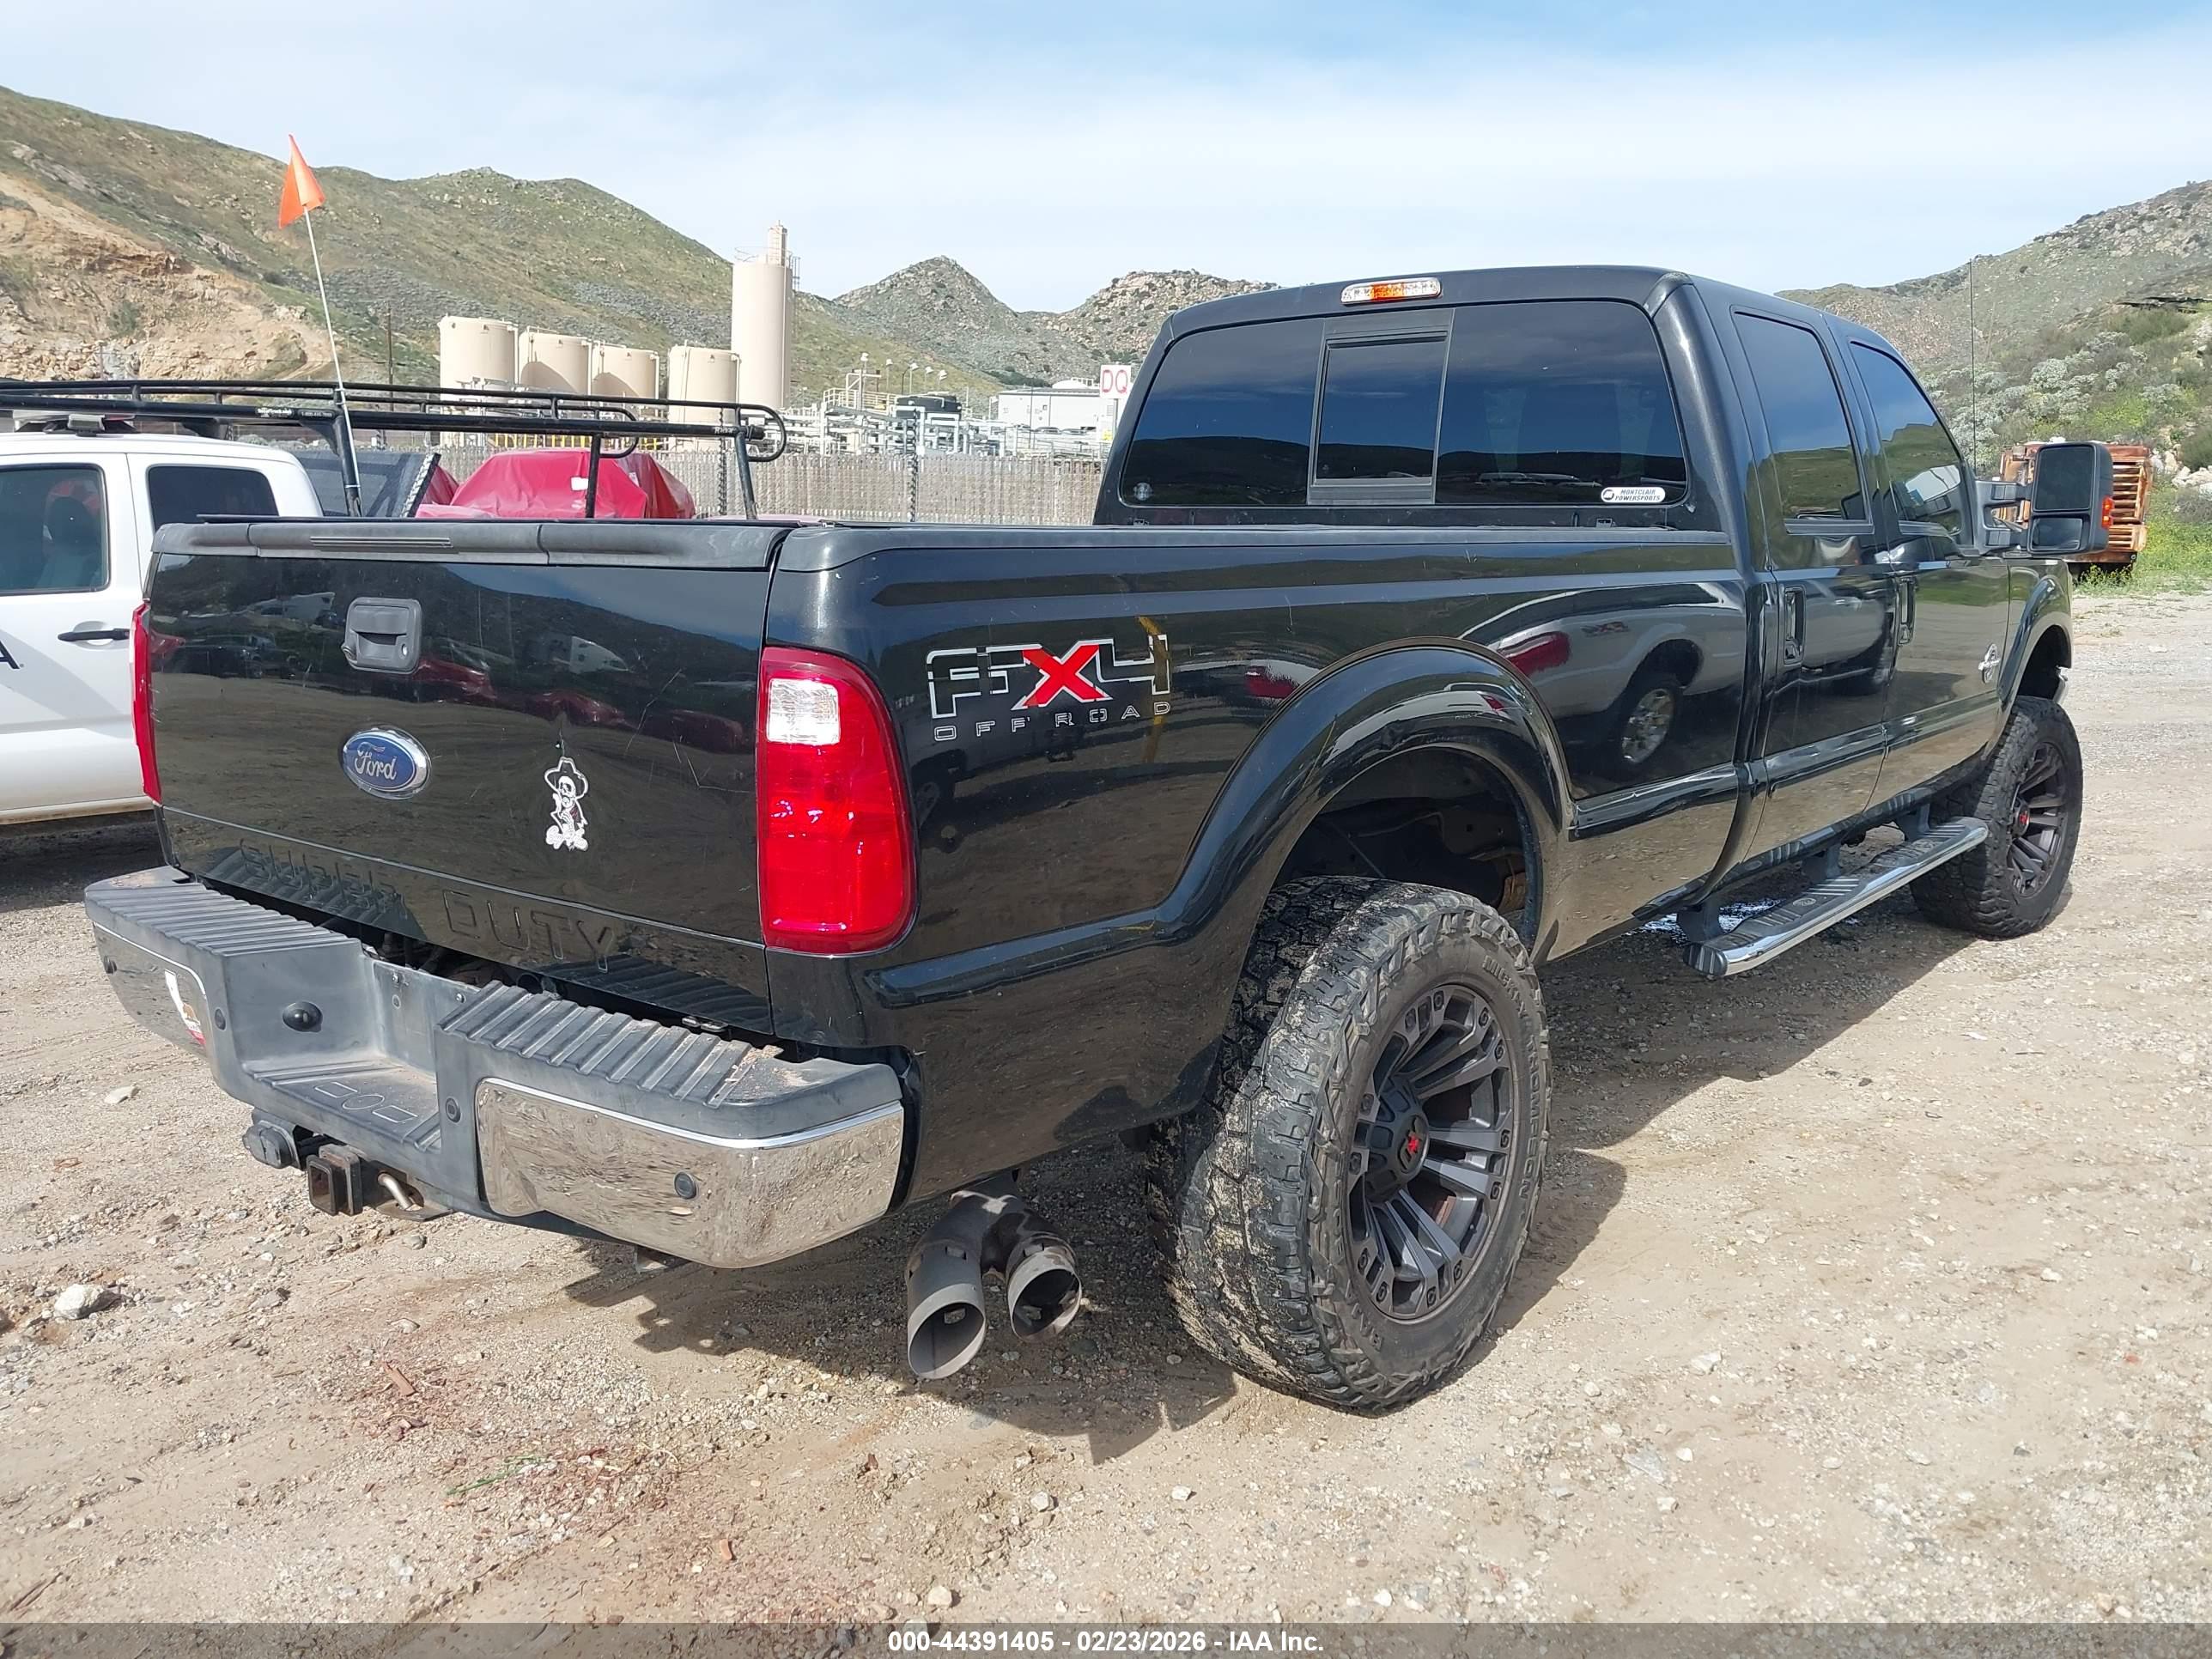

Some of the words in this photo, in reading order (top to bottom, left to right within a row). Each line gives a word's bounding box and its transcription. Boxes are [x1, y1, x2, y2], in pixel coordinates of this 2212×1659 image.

[927, 634, 1170, 719] FX4
[354, 742, 398, 781] Ford
[933, 717, 1030, 742] OFF
[1054, 701, 1171, 728] ROAD
[442, 888, 616, 974] DUTY
[1518, 1034, 1540, 1200] THOMPSON
